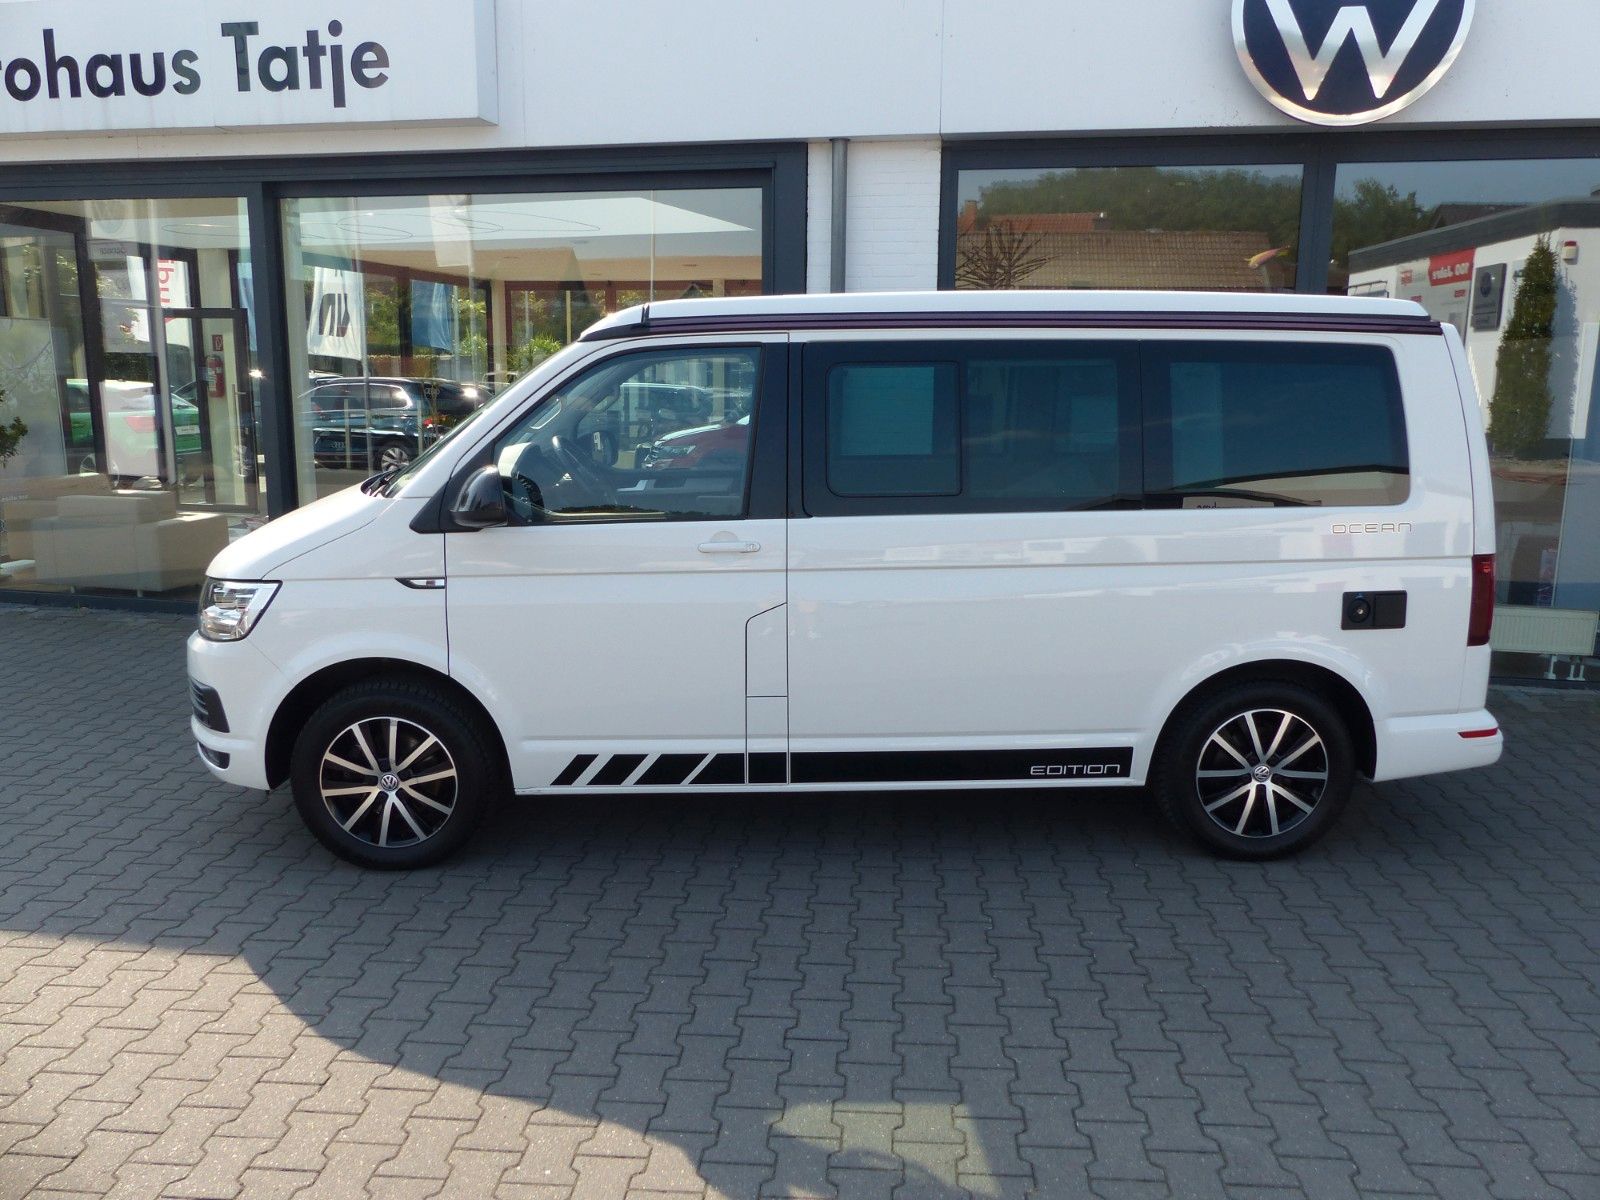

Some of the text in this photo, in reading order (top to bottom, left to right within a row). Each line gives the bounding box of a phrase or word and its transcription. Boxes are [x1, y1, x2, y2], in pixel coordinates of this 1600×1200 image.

[0, 19, 390, 108] ohaus Tatje
[1332, 522, 1412, 534] OCEAN
[1030, 764, 1121, 776] EDITION
